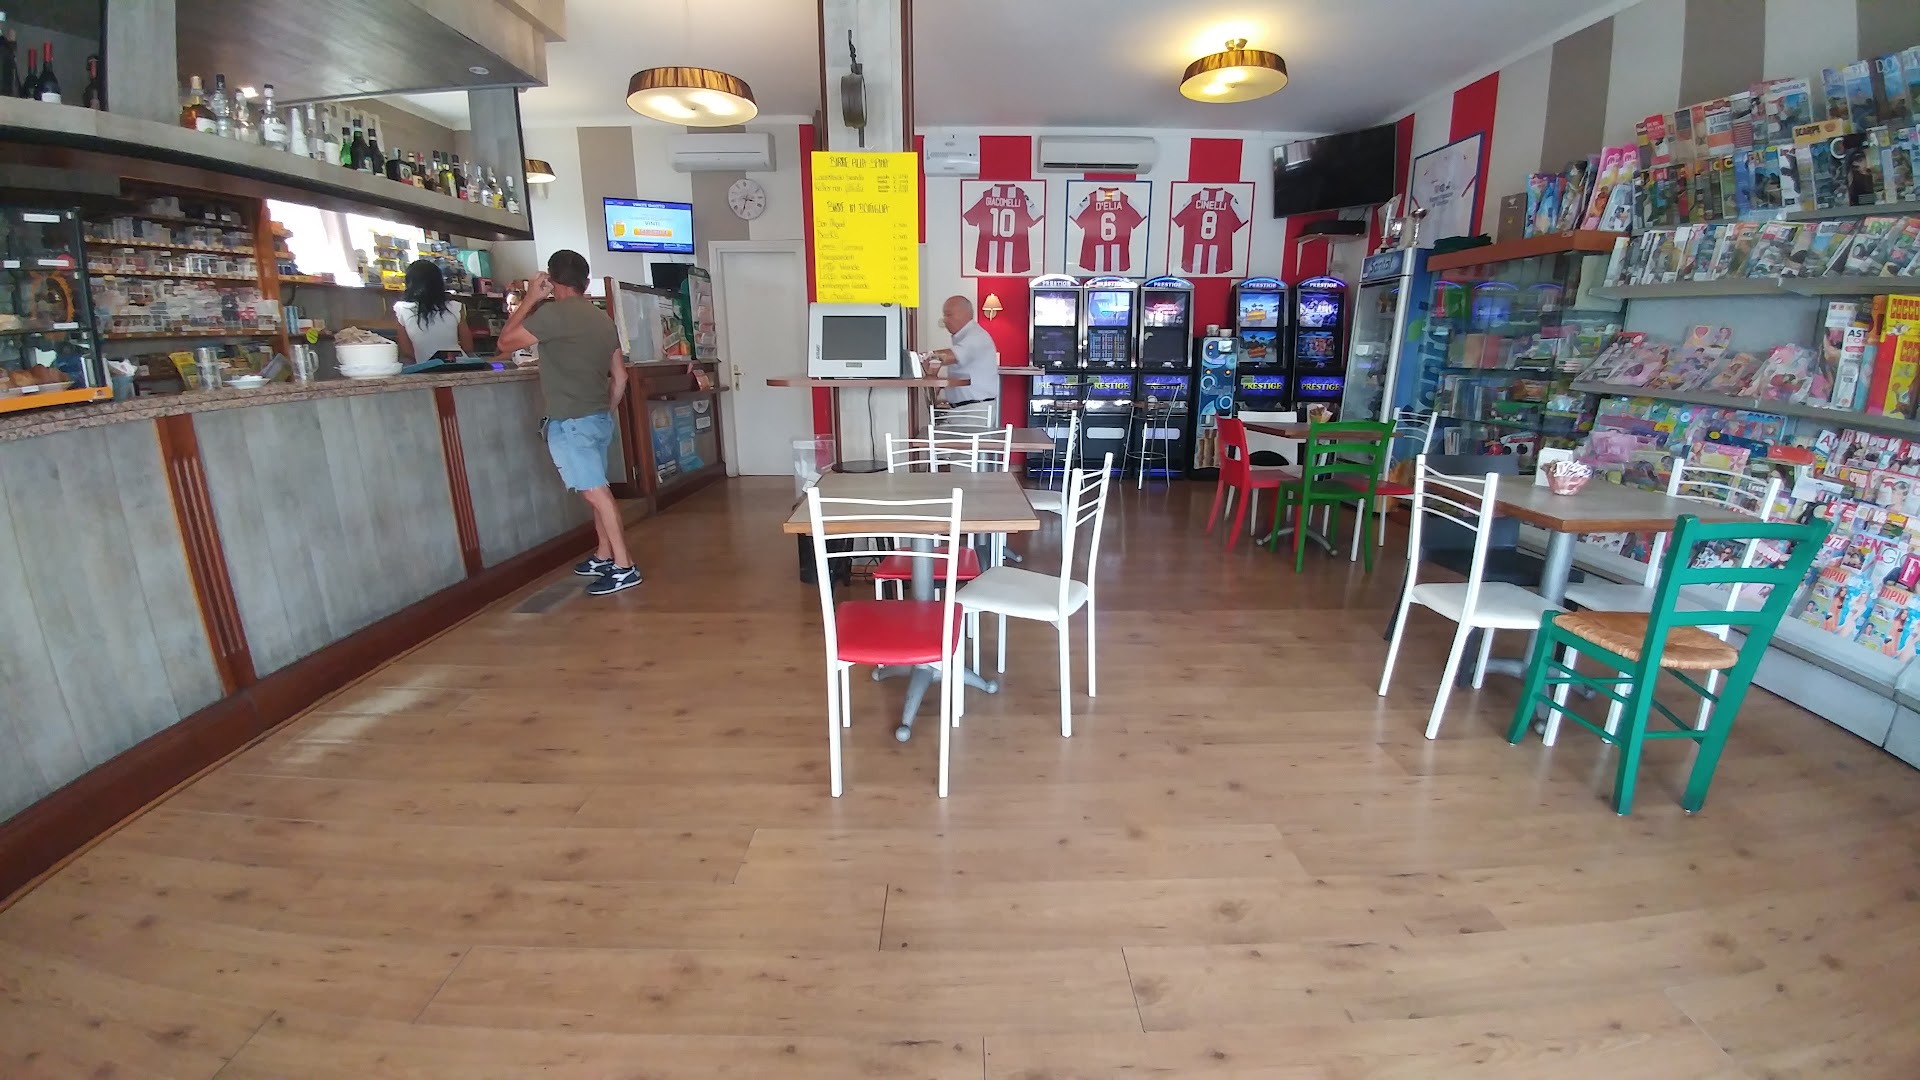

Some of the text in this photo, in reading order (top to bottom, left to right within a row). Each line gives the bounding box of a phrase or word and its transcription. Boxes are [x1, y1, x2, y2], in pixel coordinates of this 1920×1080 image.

[985, 196, 1022, 208] GIACOMELLI
[1095, 200, 1123, 211] D'ELIA
[1195, 199, 1228, 211] CINELLI
[990, 208, 1016, 238] 10
[1100, 212, 1117, 241] 6
[1201, 211, 1218, 240] 8
[1242, 382, 1283, 391] PRESTIGE
[1301, 383, 1341, 391] PRESTIGE
